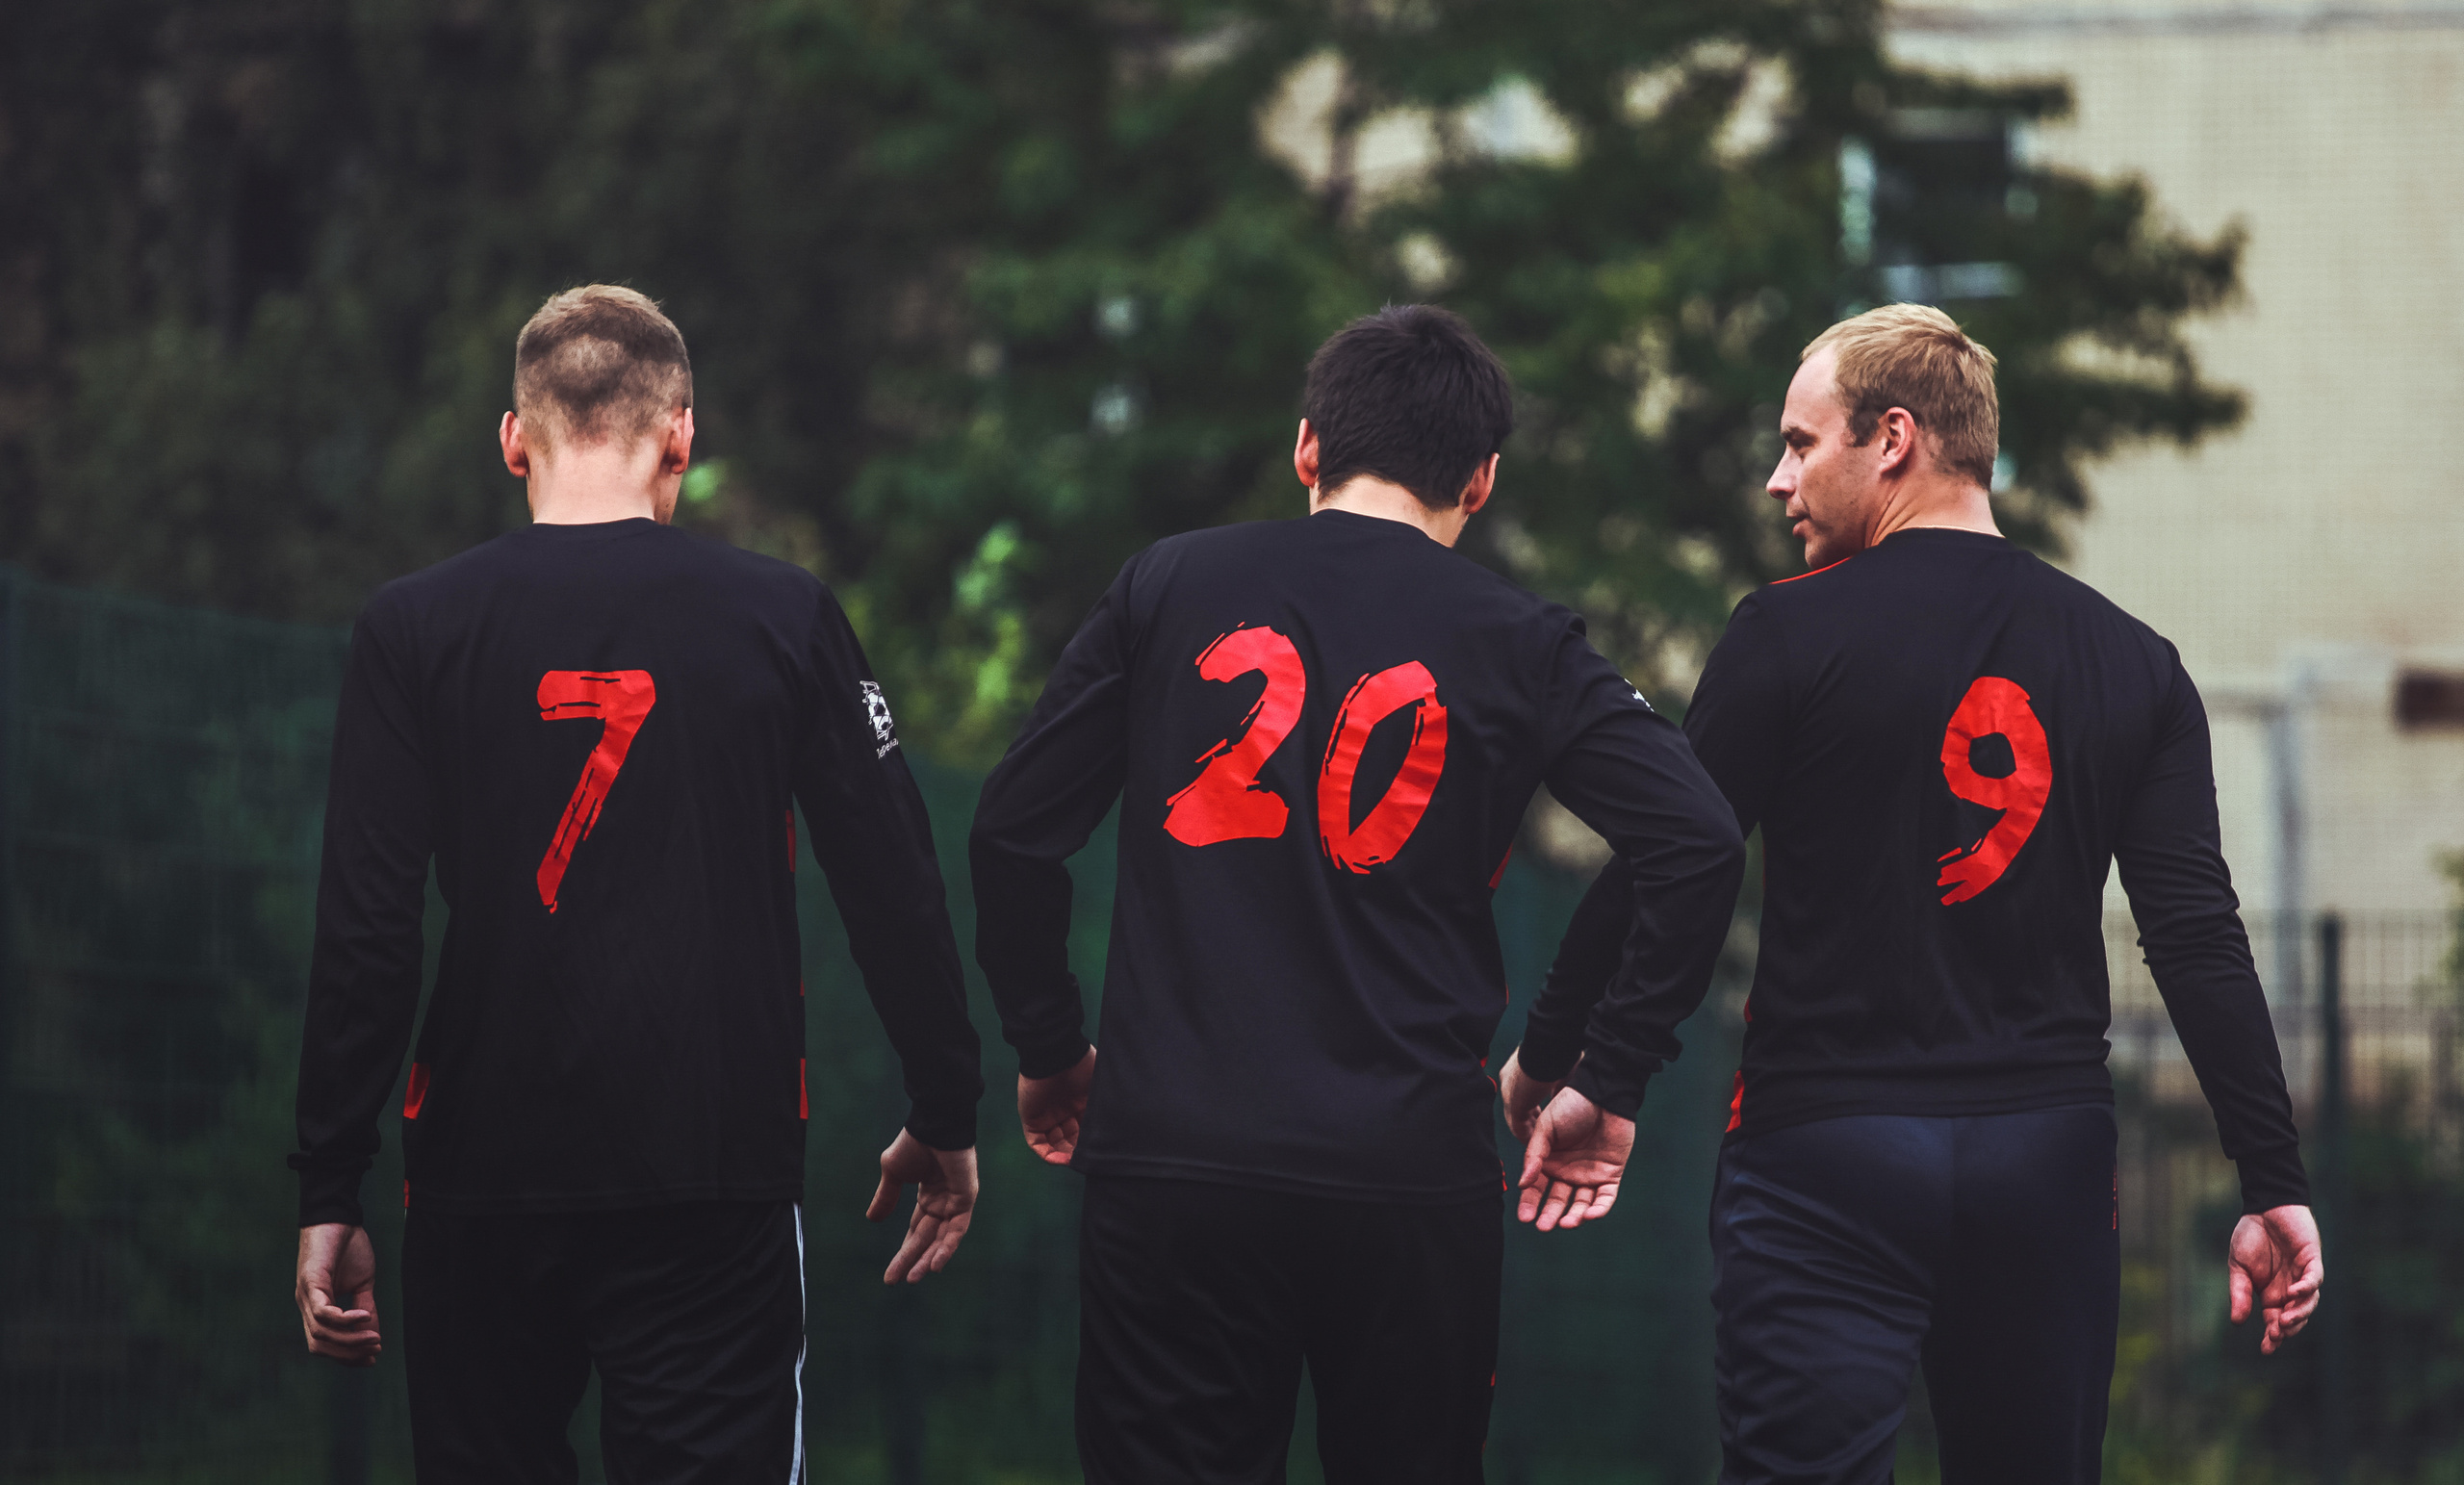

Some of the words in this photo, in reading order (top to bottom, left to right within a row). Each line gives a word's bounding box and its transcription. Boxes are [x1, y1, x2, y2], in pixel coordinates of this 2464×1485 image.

[537, 669, 656, 913] 7
[1162, 622, 1449, 875] 20
[1938, 676, 2054, 906] 9
